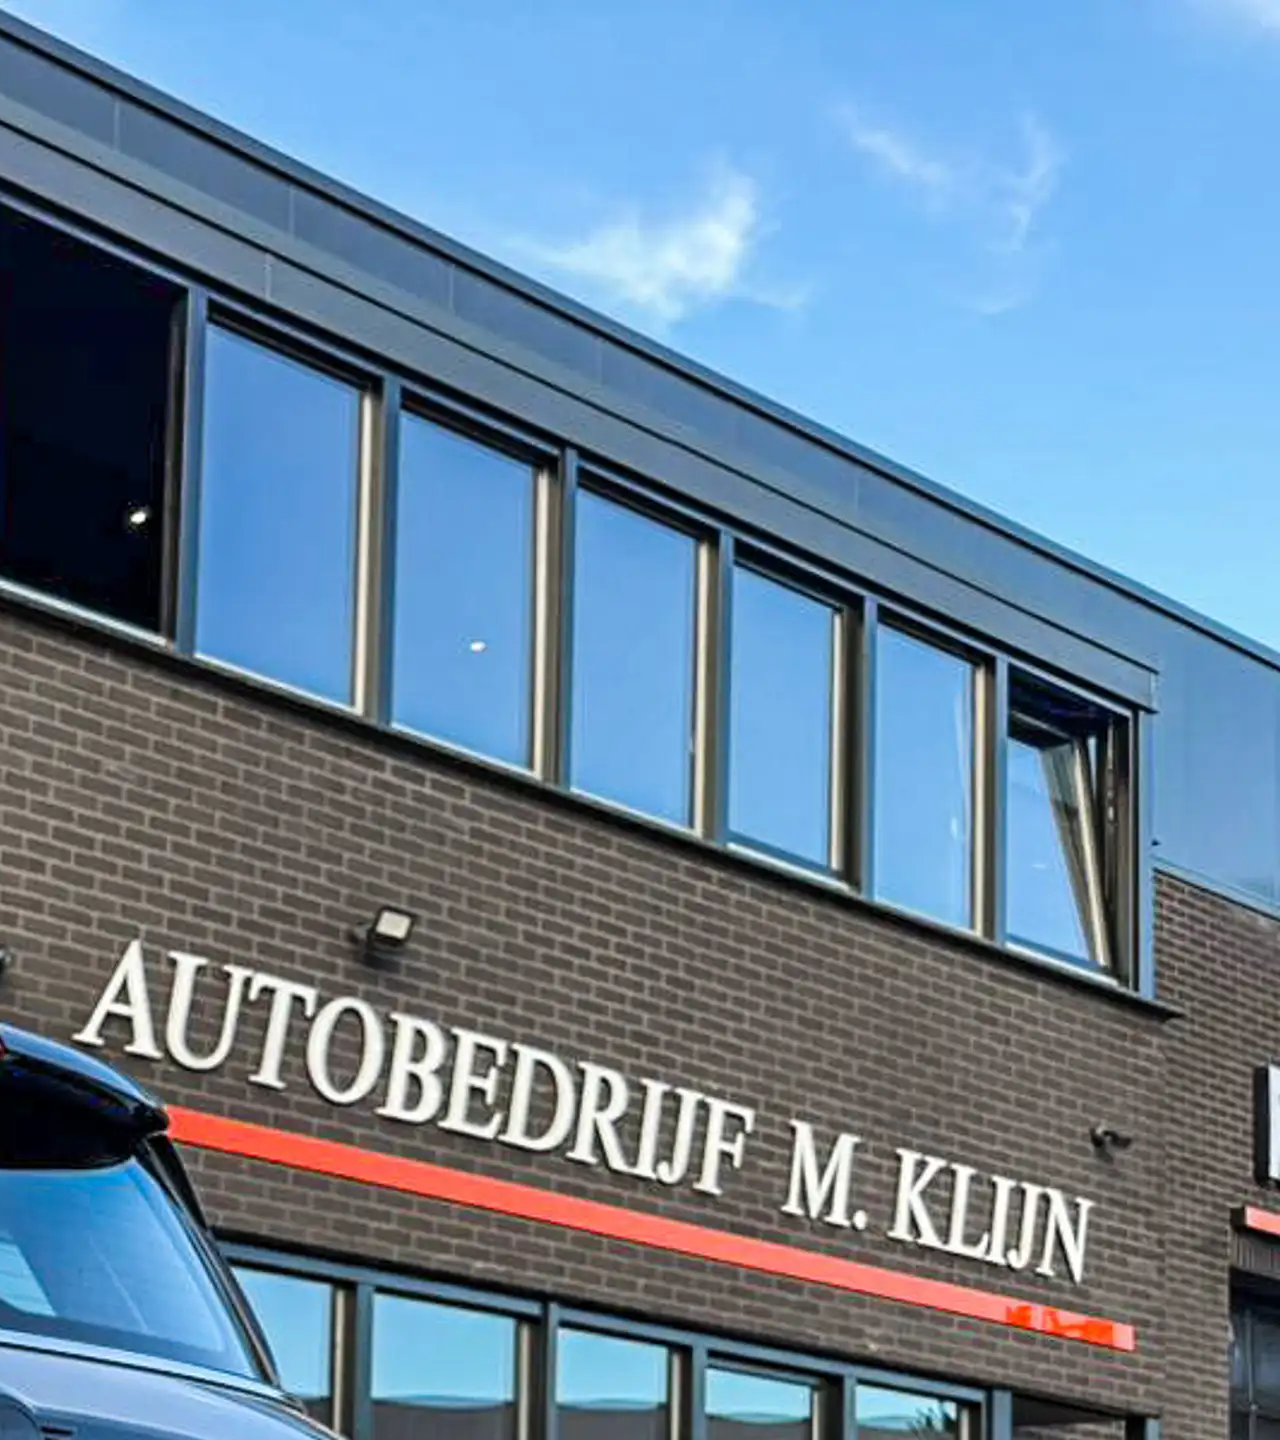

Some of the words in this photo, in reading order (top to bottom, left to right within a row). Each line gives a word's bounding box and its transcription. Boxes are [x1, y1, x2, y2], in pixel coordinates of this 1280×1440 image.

[72, 938, 756, 1196] AUTOBEDRIJF
[780, 1118, 868, 1232] M.
[886, 1147, 1096, 1285] KLIJN
